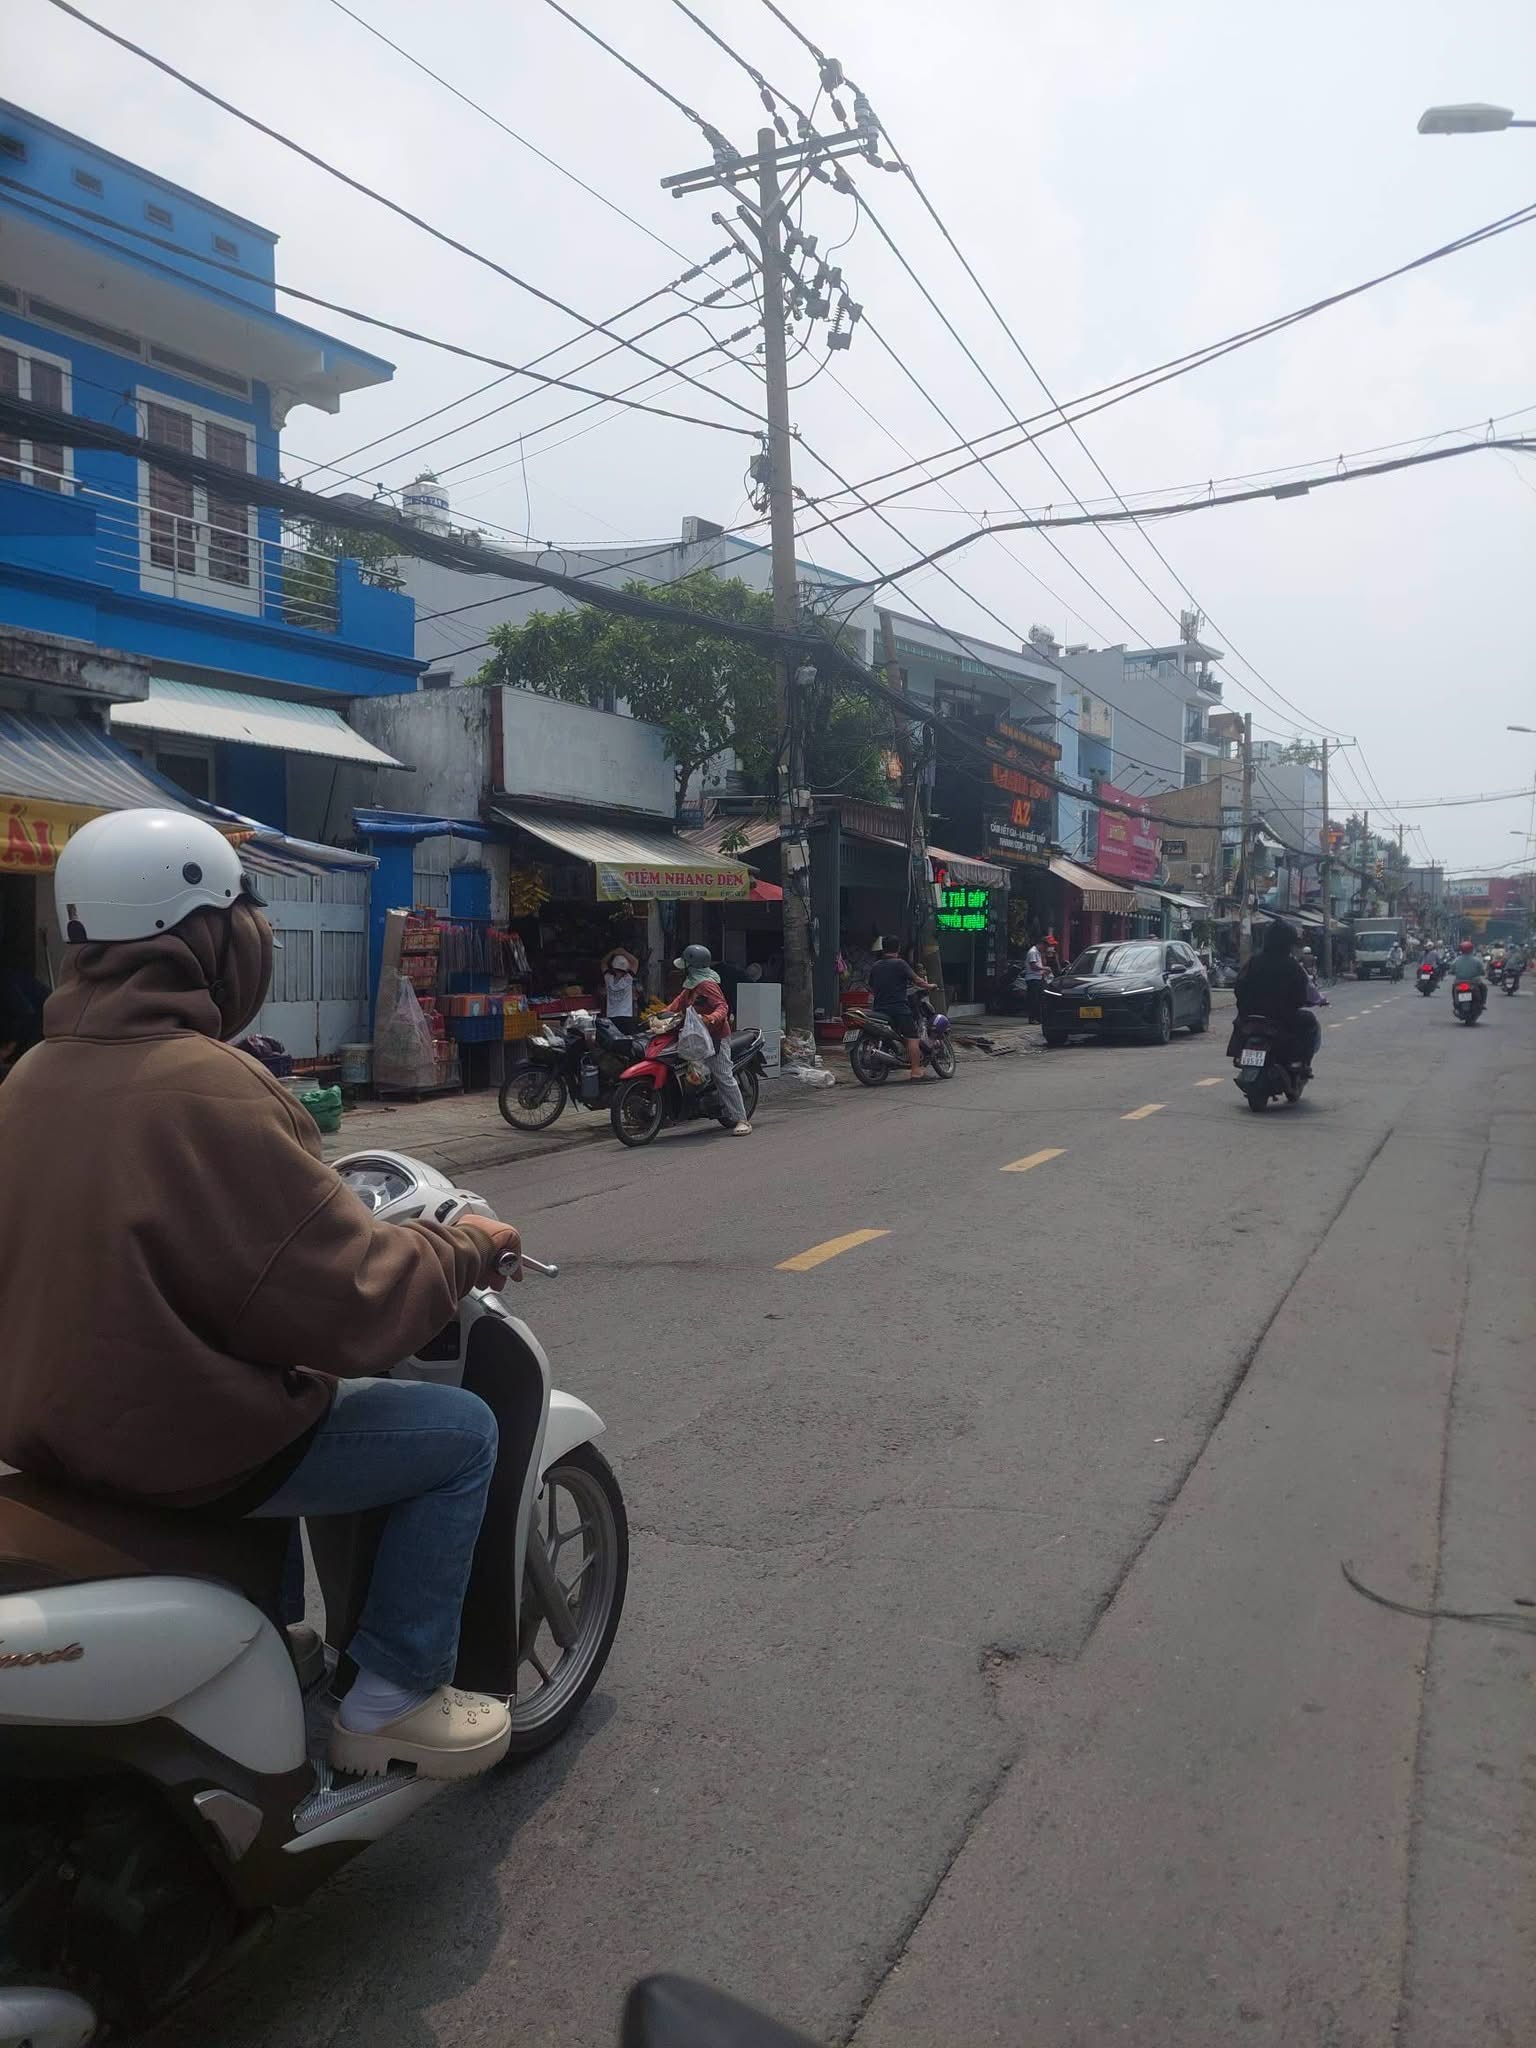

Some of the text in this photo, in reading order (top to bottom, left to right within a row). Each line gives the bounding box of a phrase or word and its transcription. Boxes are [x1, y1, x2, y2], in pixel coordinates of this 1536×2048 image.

[624, 868, 660, 887] TIỆM
[665, 872, 714, 886] NHANG
[949, 888, 966, 908] TRẢ
[968, 889, 986, 908] GÓP
